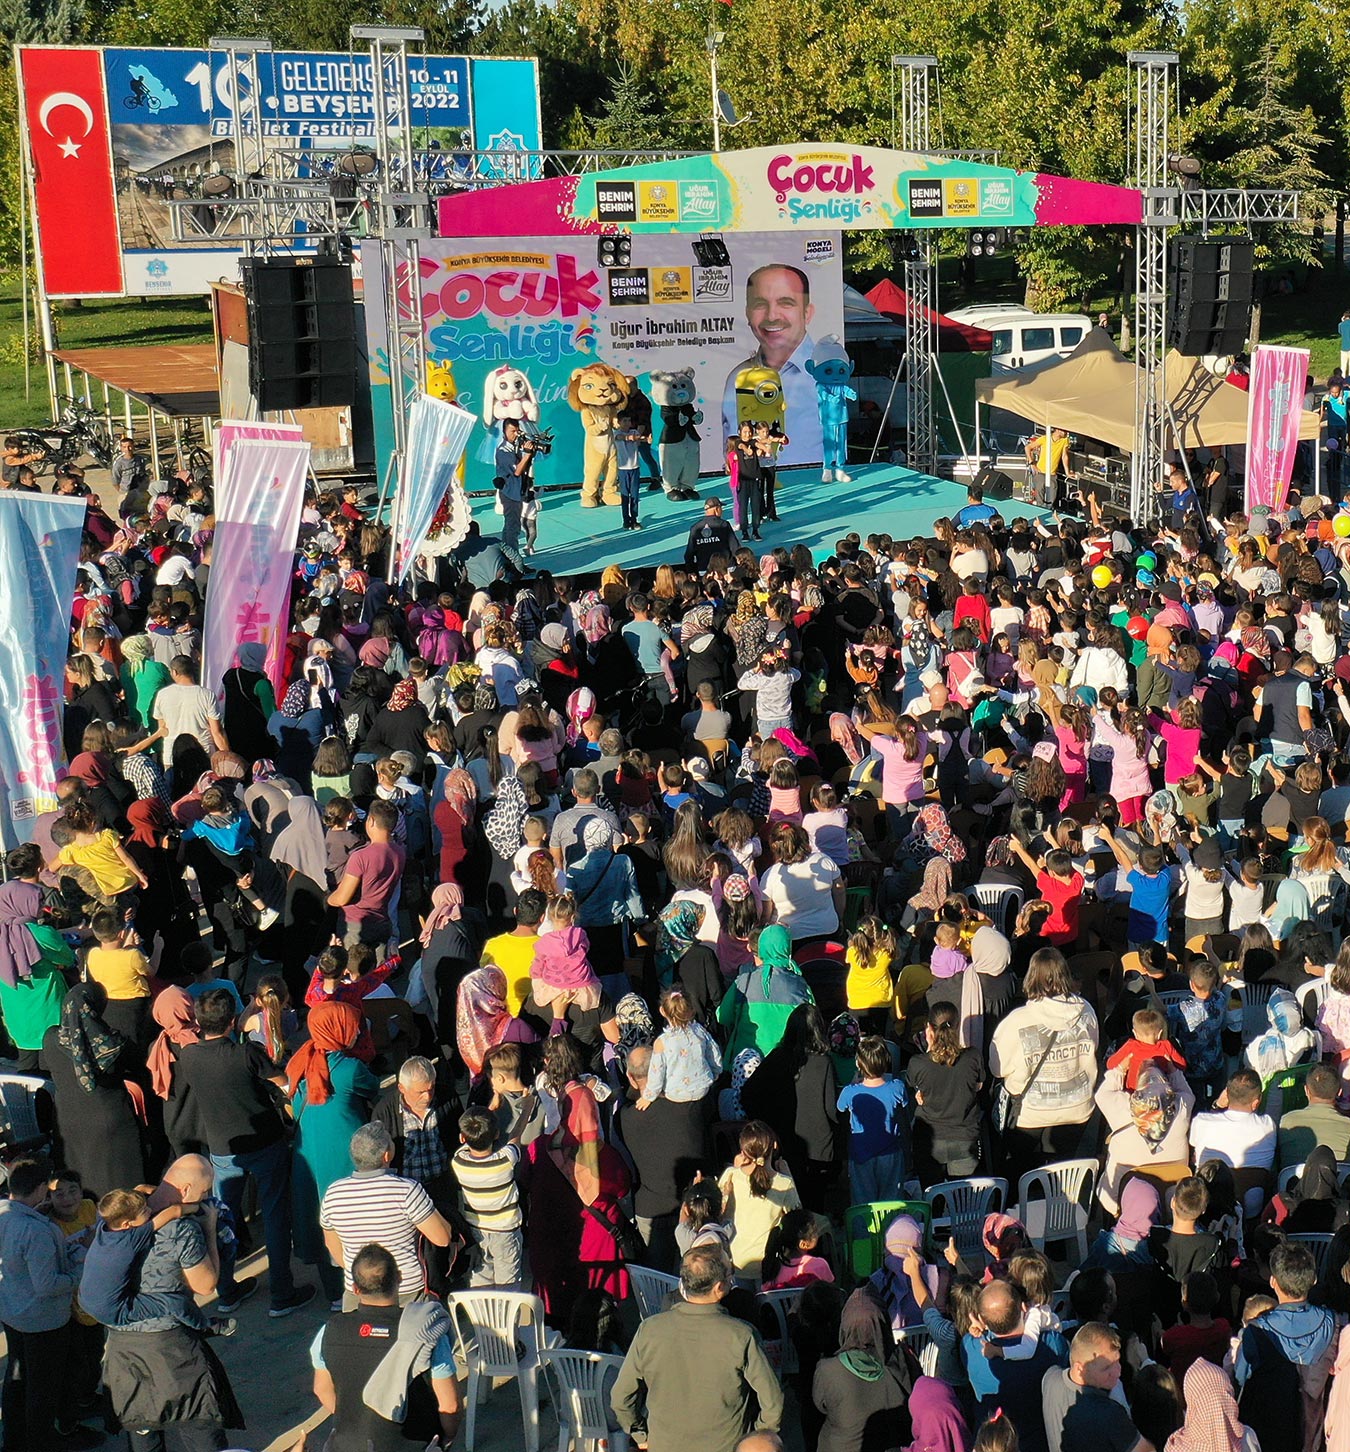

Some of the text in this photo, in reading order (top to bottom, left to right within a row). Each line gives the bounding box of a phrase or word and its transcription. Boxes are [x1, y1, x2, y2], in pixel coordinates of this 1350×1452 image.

[409, 69, 430, 84] 10
[443, 70, 459, 84] 11
[283, 94, 399, 118] BEYŞEHR
[411, 93, 460, 109] 2022
[767, 152, 876, 204] Çocuk
[598, 191, 634, 202] BENİM
[911, 188, 941, 198] BENİM
[599, 202, 634, 214] ŞEHRİM
[682, 198, 717, 216] Altay
[787, 198, 862, 224] Şenliği
[911, 198, 941, 209] ŞEHRİM
[806, 240, 832, 248] KONYA
[450, 254, 545, 267] KONYA BÜYÜKŞEHİR BELEDİYESİ
[611, 276, 646, 287] BENİM
[695, 279, 730, 297] Altay
[611, 287, 647, 298] ŞEHRİM
[610, 317, 735, 340] Uğur İbrahim ALTAY
[612, 336, 735, 351] Konya Büyükşehir Belediye Başkanı
